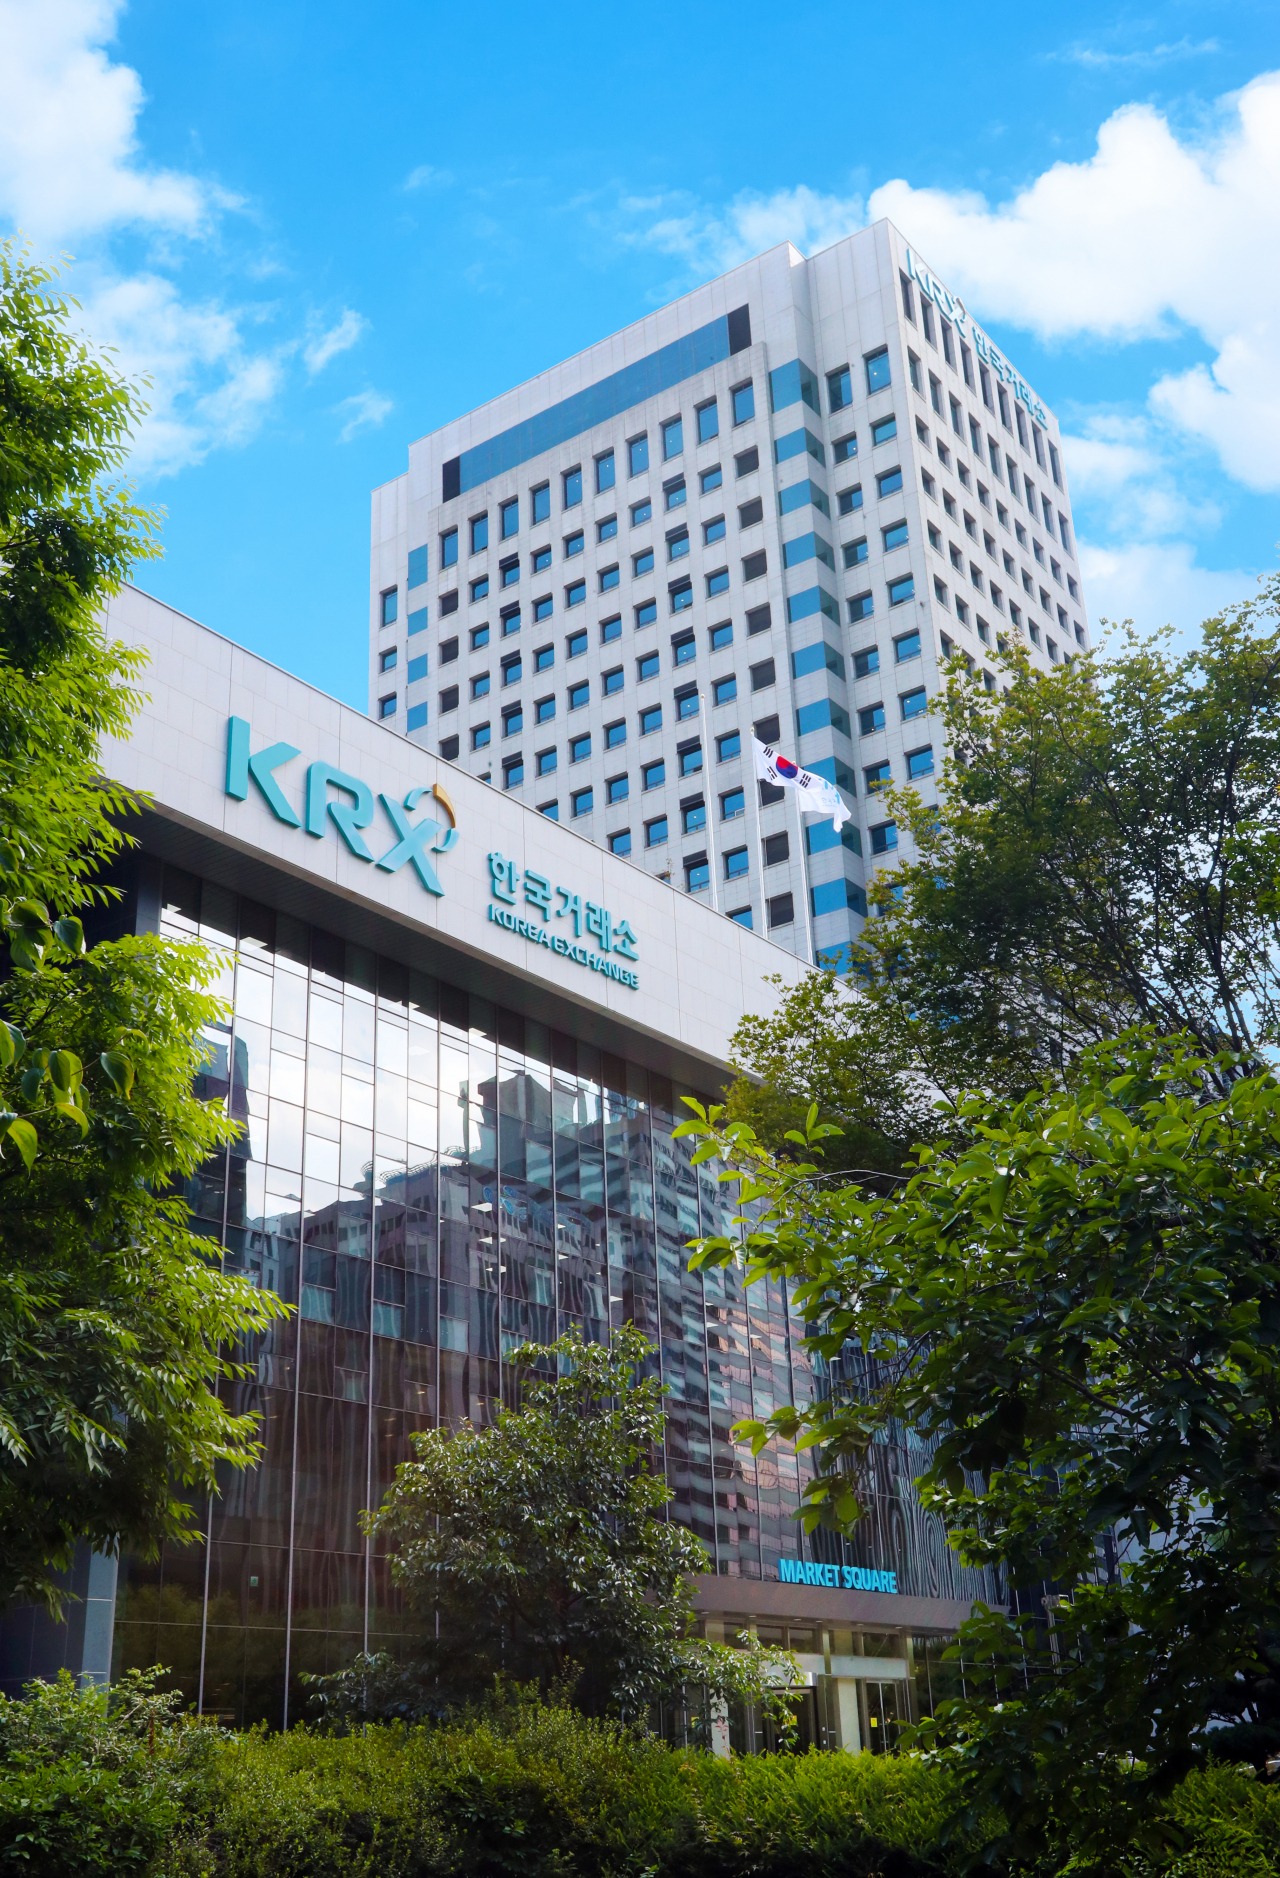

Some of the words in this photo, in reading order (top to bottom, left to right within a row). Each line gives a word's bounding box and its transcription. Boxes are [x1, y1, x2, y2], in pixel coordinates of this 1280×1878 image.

[907, 248, 967, 338] KRX
[972, 326, 1048, 430] 한국거래소
[226, 715, 459, 897] KRX
[488, 852, 640, 961] 한국거래소
[488, 903, 551, 948] KOREA
[552, 935, 640, 990] EXCHANGE
[778, 1558, 840, 1587] MARKET
[841, 1566, 898, 1593] SQUARE
